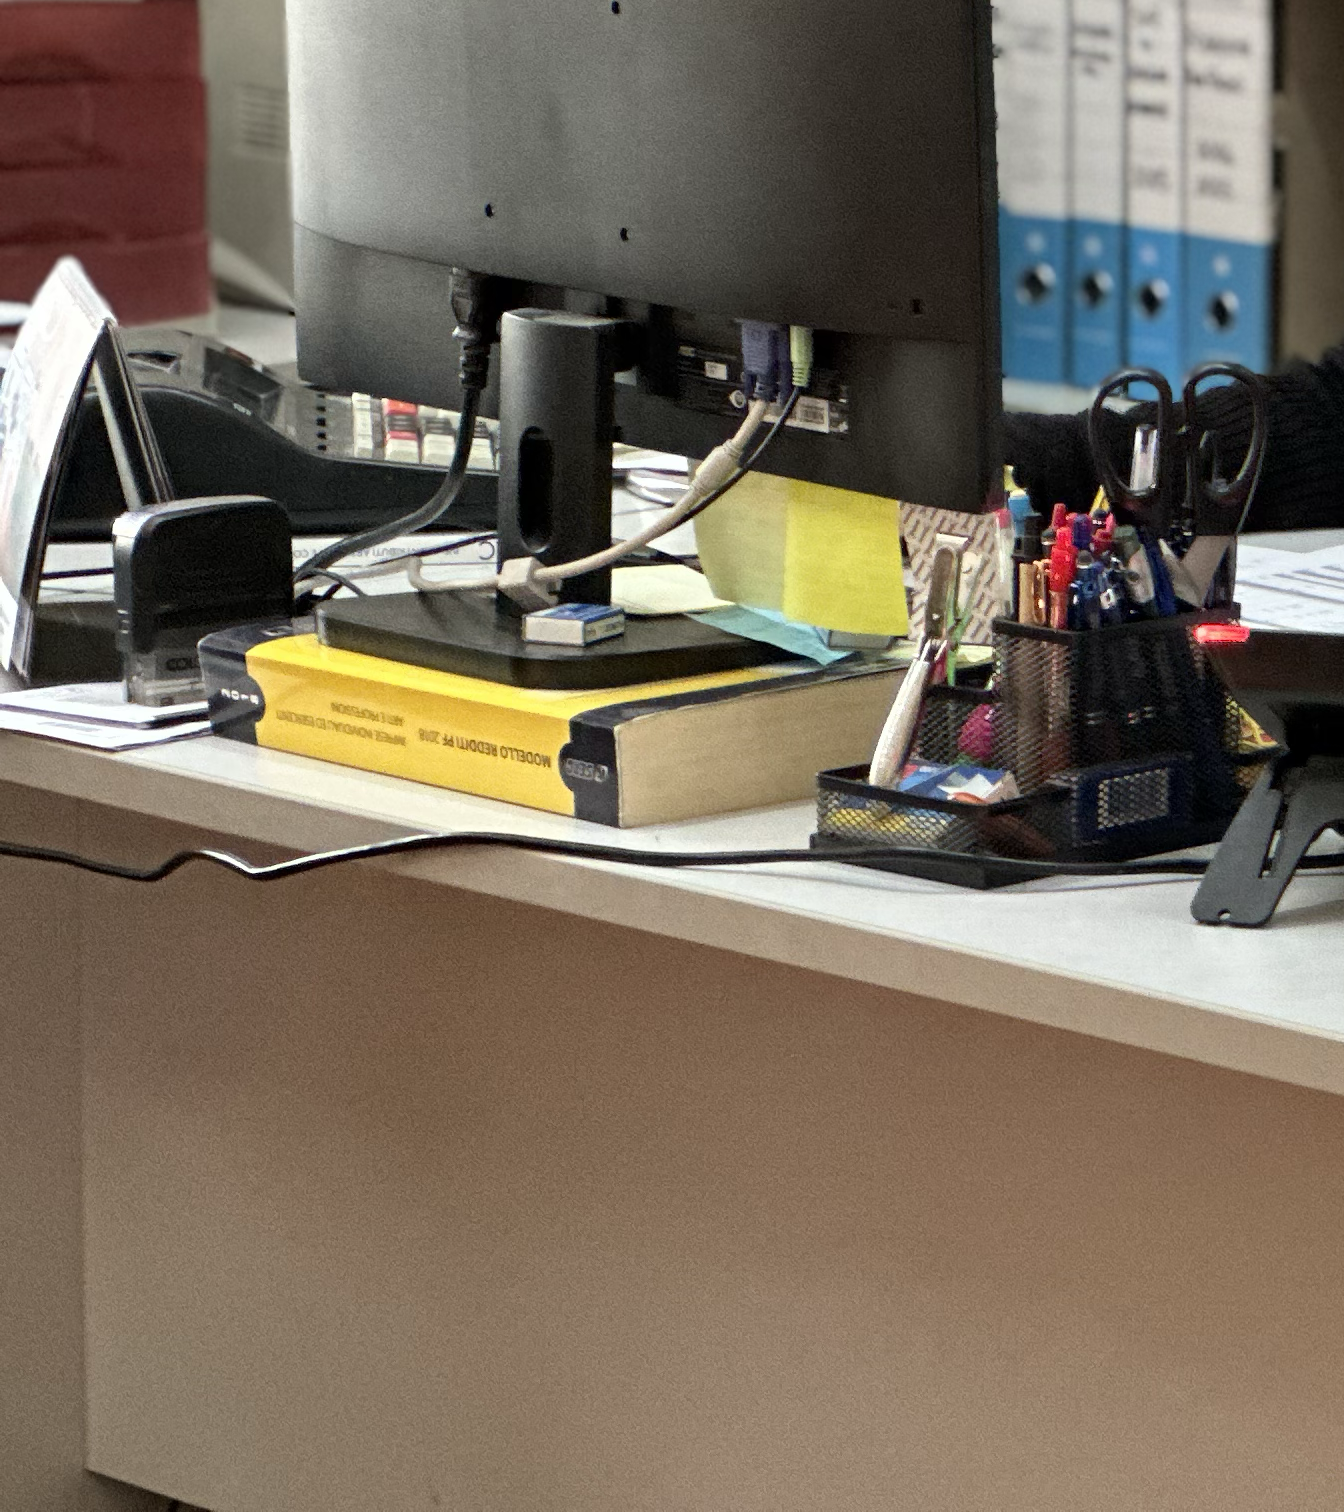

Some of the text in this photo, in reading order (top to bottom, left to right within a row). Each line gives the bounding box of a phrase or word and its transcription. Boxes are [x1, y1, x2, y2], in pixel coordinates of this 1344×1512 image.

[440, 733, 455, 748] PF
[454, 735, 498, 757] REDDITI
[499, 745, 552, 768] MODELLO
